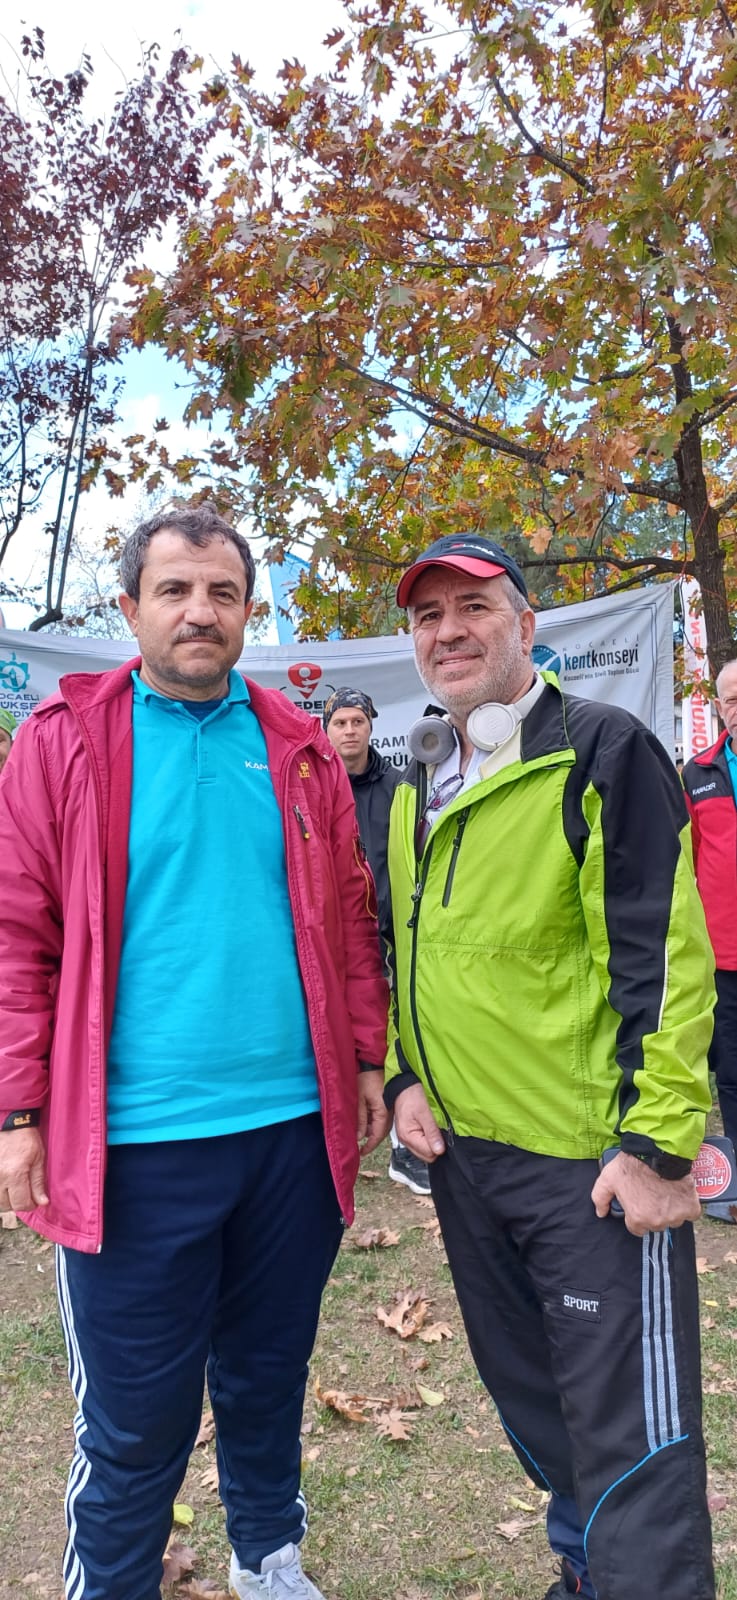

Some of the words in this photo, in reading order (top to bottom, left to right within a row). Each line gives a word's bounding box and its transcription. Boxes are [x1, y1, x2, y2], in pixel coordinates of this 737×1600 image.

[563, 644, 639, 671] kentkonseyi
[294, 700, 327, 710] EDE
[563, 1294, 599, 1313] SPORT
